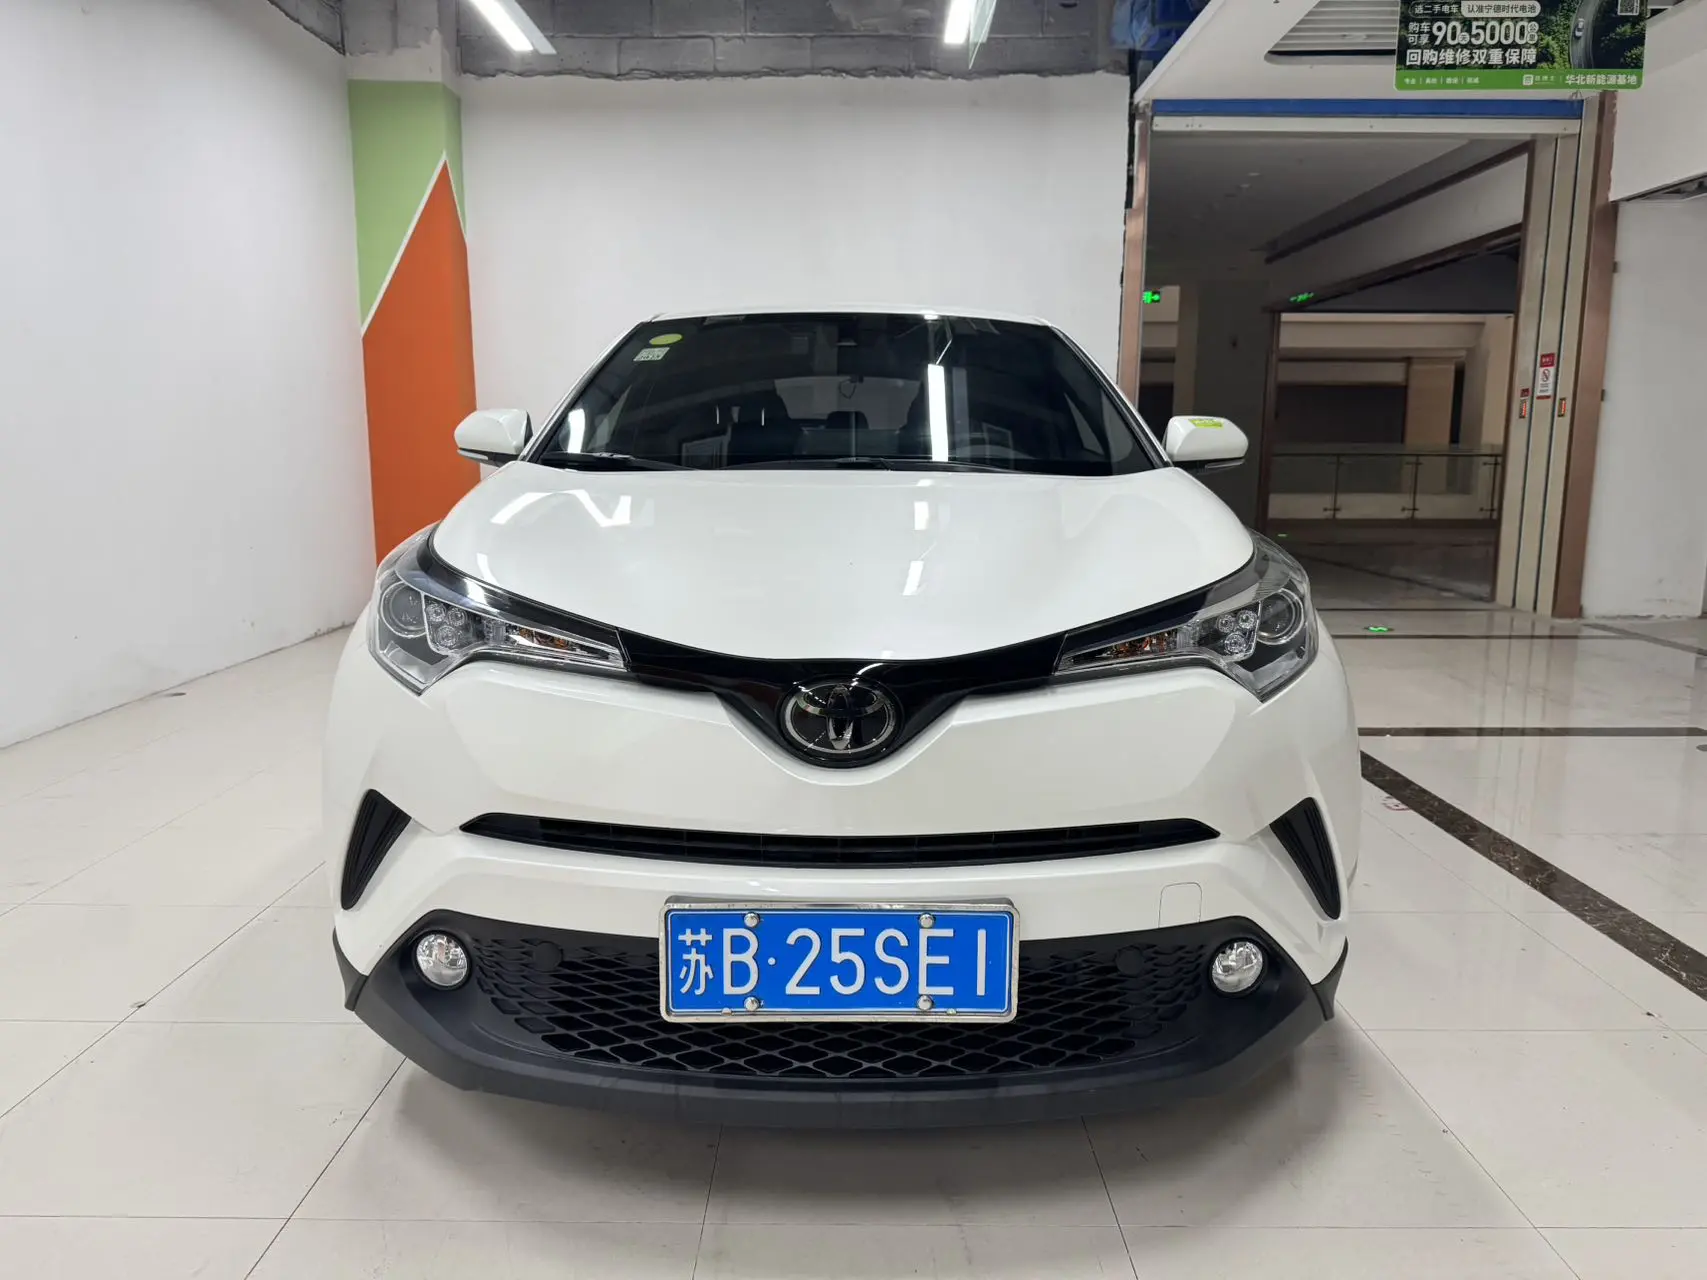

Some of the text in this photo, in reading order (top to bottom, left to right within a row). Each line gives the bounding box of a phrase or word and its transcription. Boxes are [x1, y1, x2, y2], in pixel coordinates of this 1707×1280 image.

[1467, 4, 1537, 14] 认准宁德时代电池
[1408, 22, 1431, 33] 购车
[1408, 34, 1430, 45] 可享
[1406, 49, 1537, 66] 回购维修双重保障
[1565, 74, 1637, 85] 华北新能源基地
